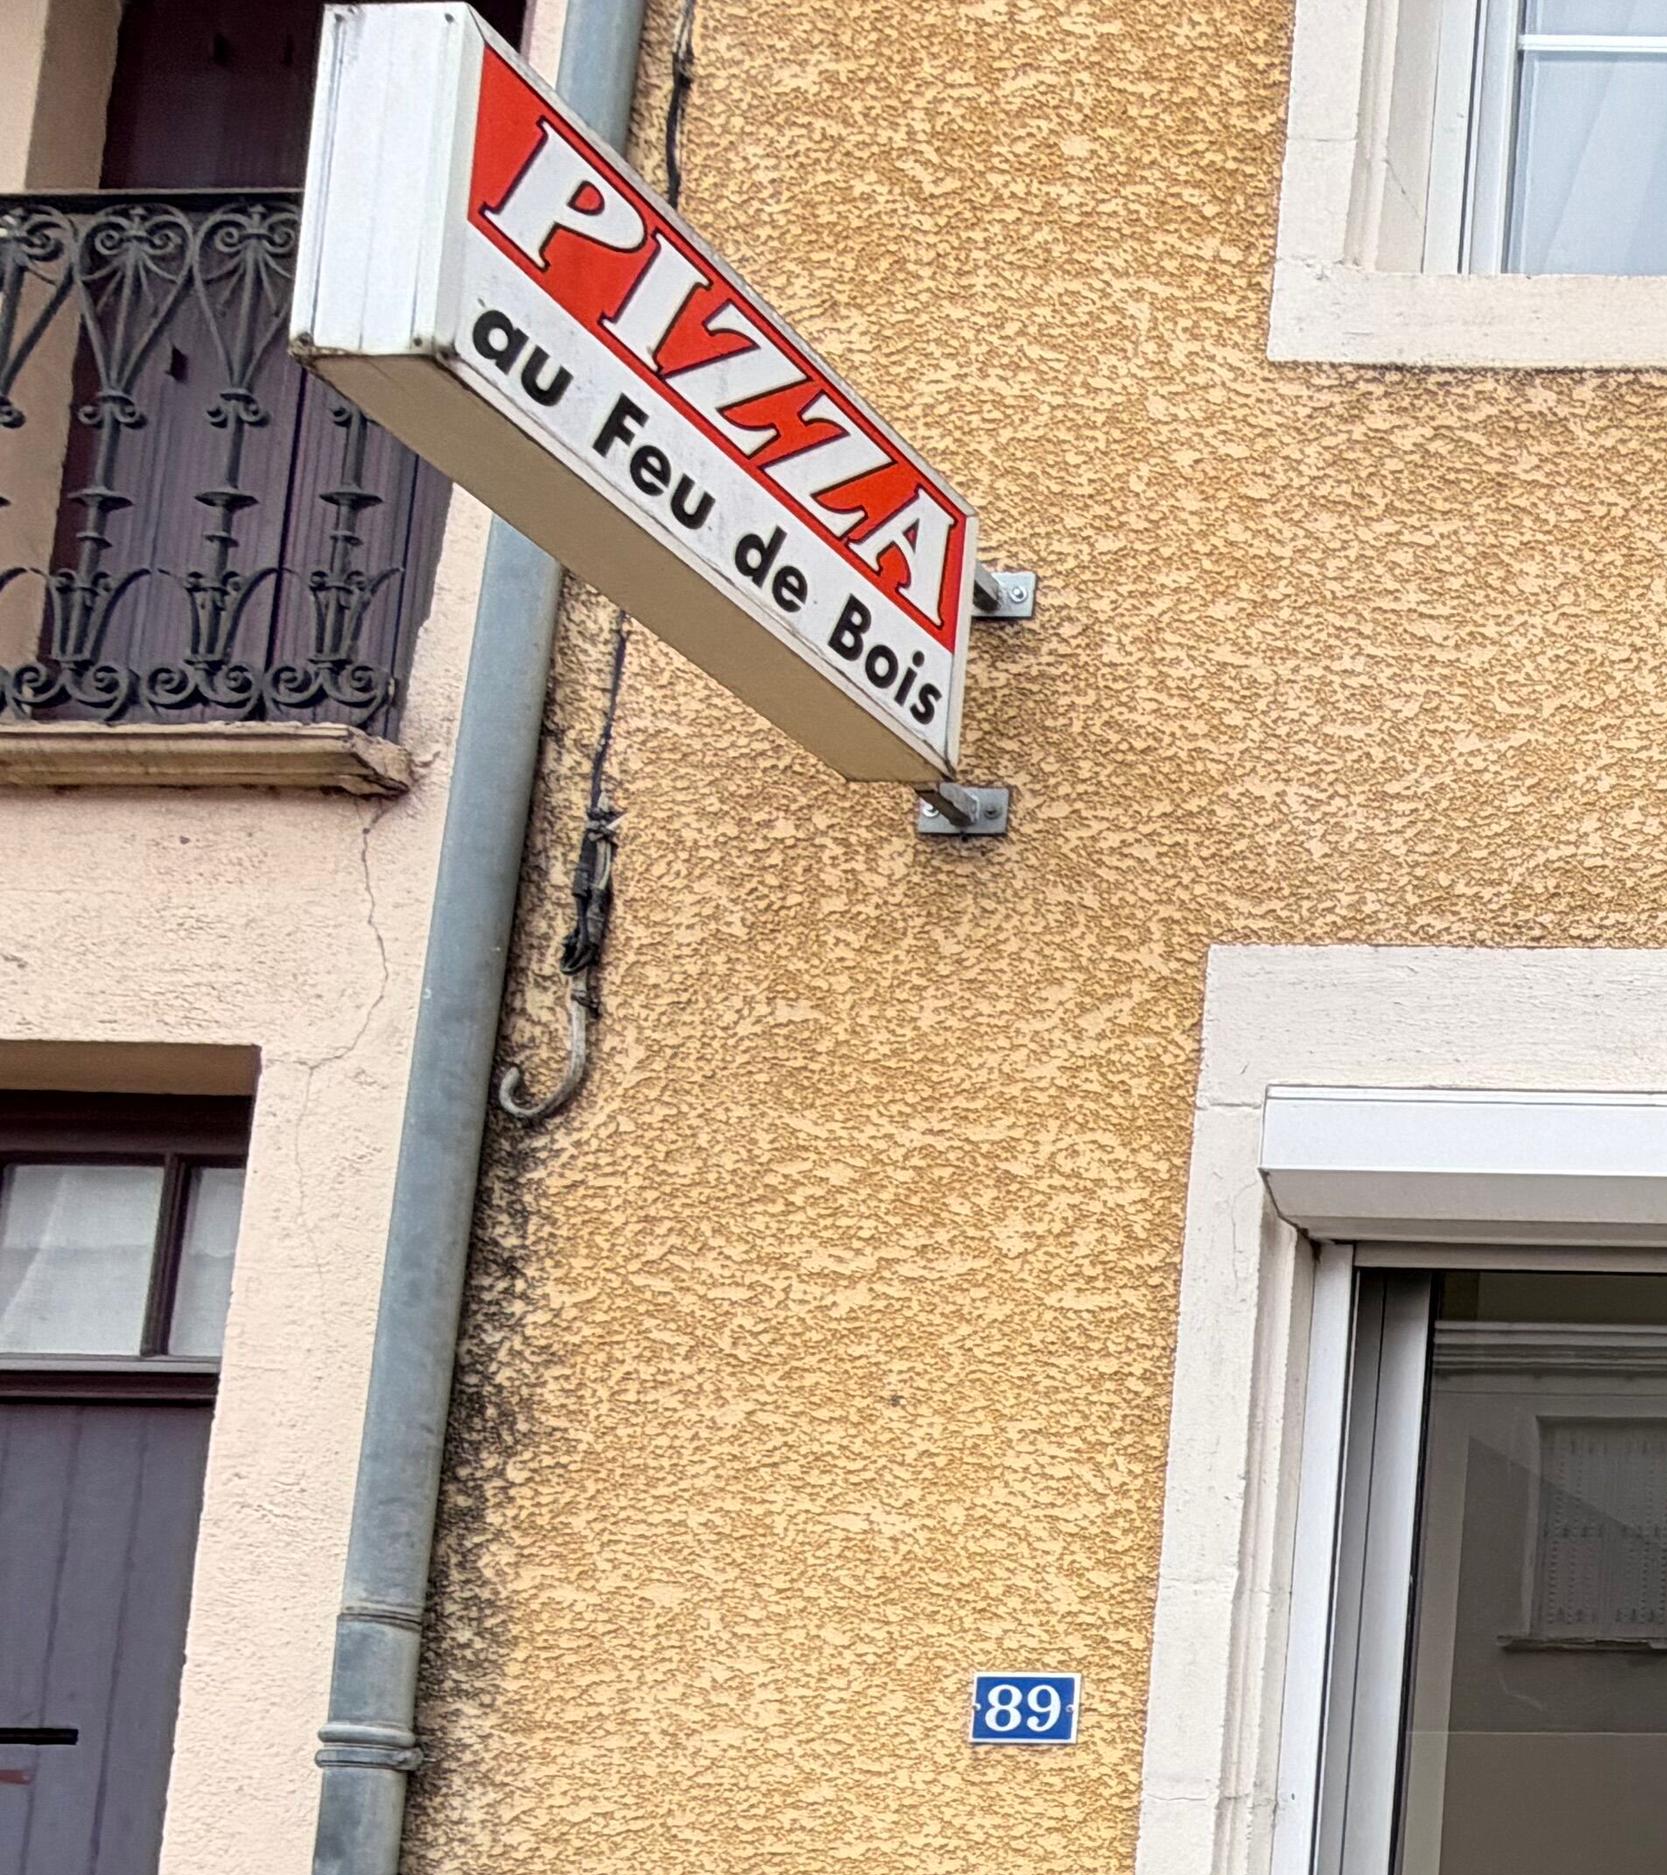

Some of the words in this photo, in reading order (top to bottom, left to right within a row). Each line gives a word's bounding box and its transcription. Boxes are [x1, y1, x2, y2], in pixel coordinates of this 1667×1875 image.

[471, 307, 573, 408] au
[592, 392, 716, 531] Feu
[734, 527, 808, 614] de
[827, 594, 943, 726] Bois
[481, 116, 957, 630] PIZZA
[983, 1684, 1063, 1733] 89
